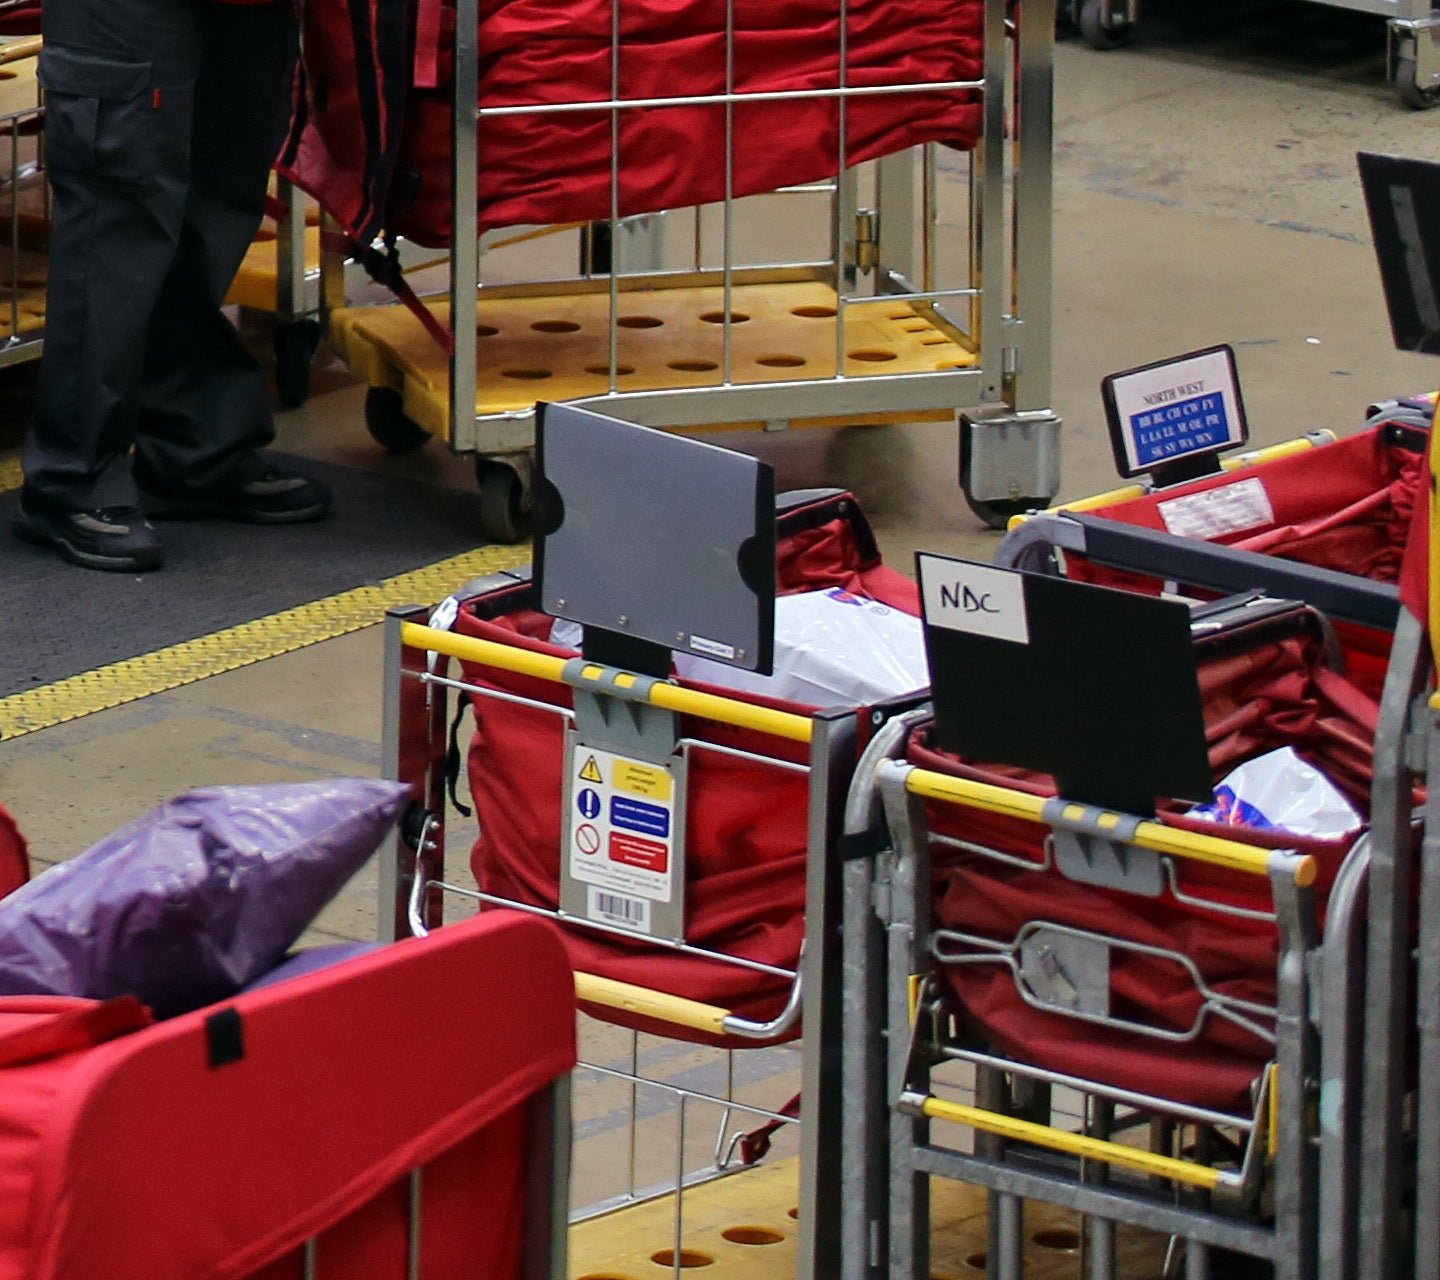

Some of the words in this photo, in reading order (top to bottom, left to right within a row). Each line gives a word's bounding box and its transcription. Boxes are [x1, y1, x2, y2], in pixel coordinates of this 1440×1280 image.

[1142, 387, 1177, 405] NORTH
[1177, 380, 1205, 395] WEST
[1152, 411, 1165, 423] BL
[1166, 407, 1181, 420] CH
[1183, 402, 1199, 415] CW
[1202, 398, 1215, 411] FY
[1140, 433, 1148, 444] L
[1162, 426, 1175, 438] LL
[1204, 413, 1220, 426] PR
[1195, 432, 1213, 444] WN
[940, 581, 1001, 613] NDC
